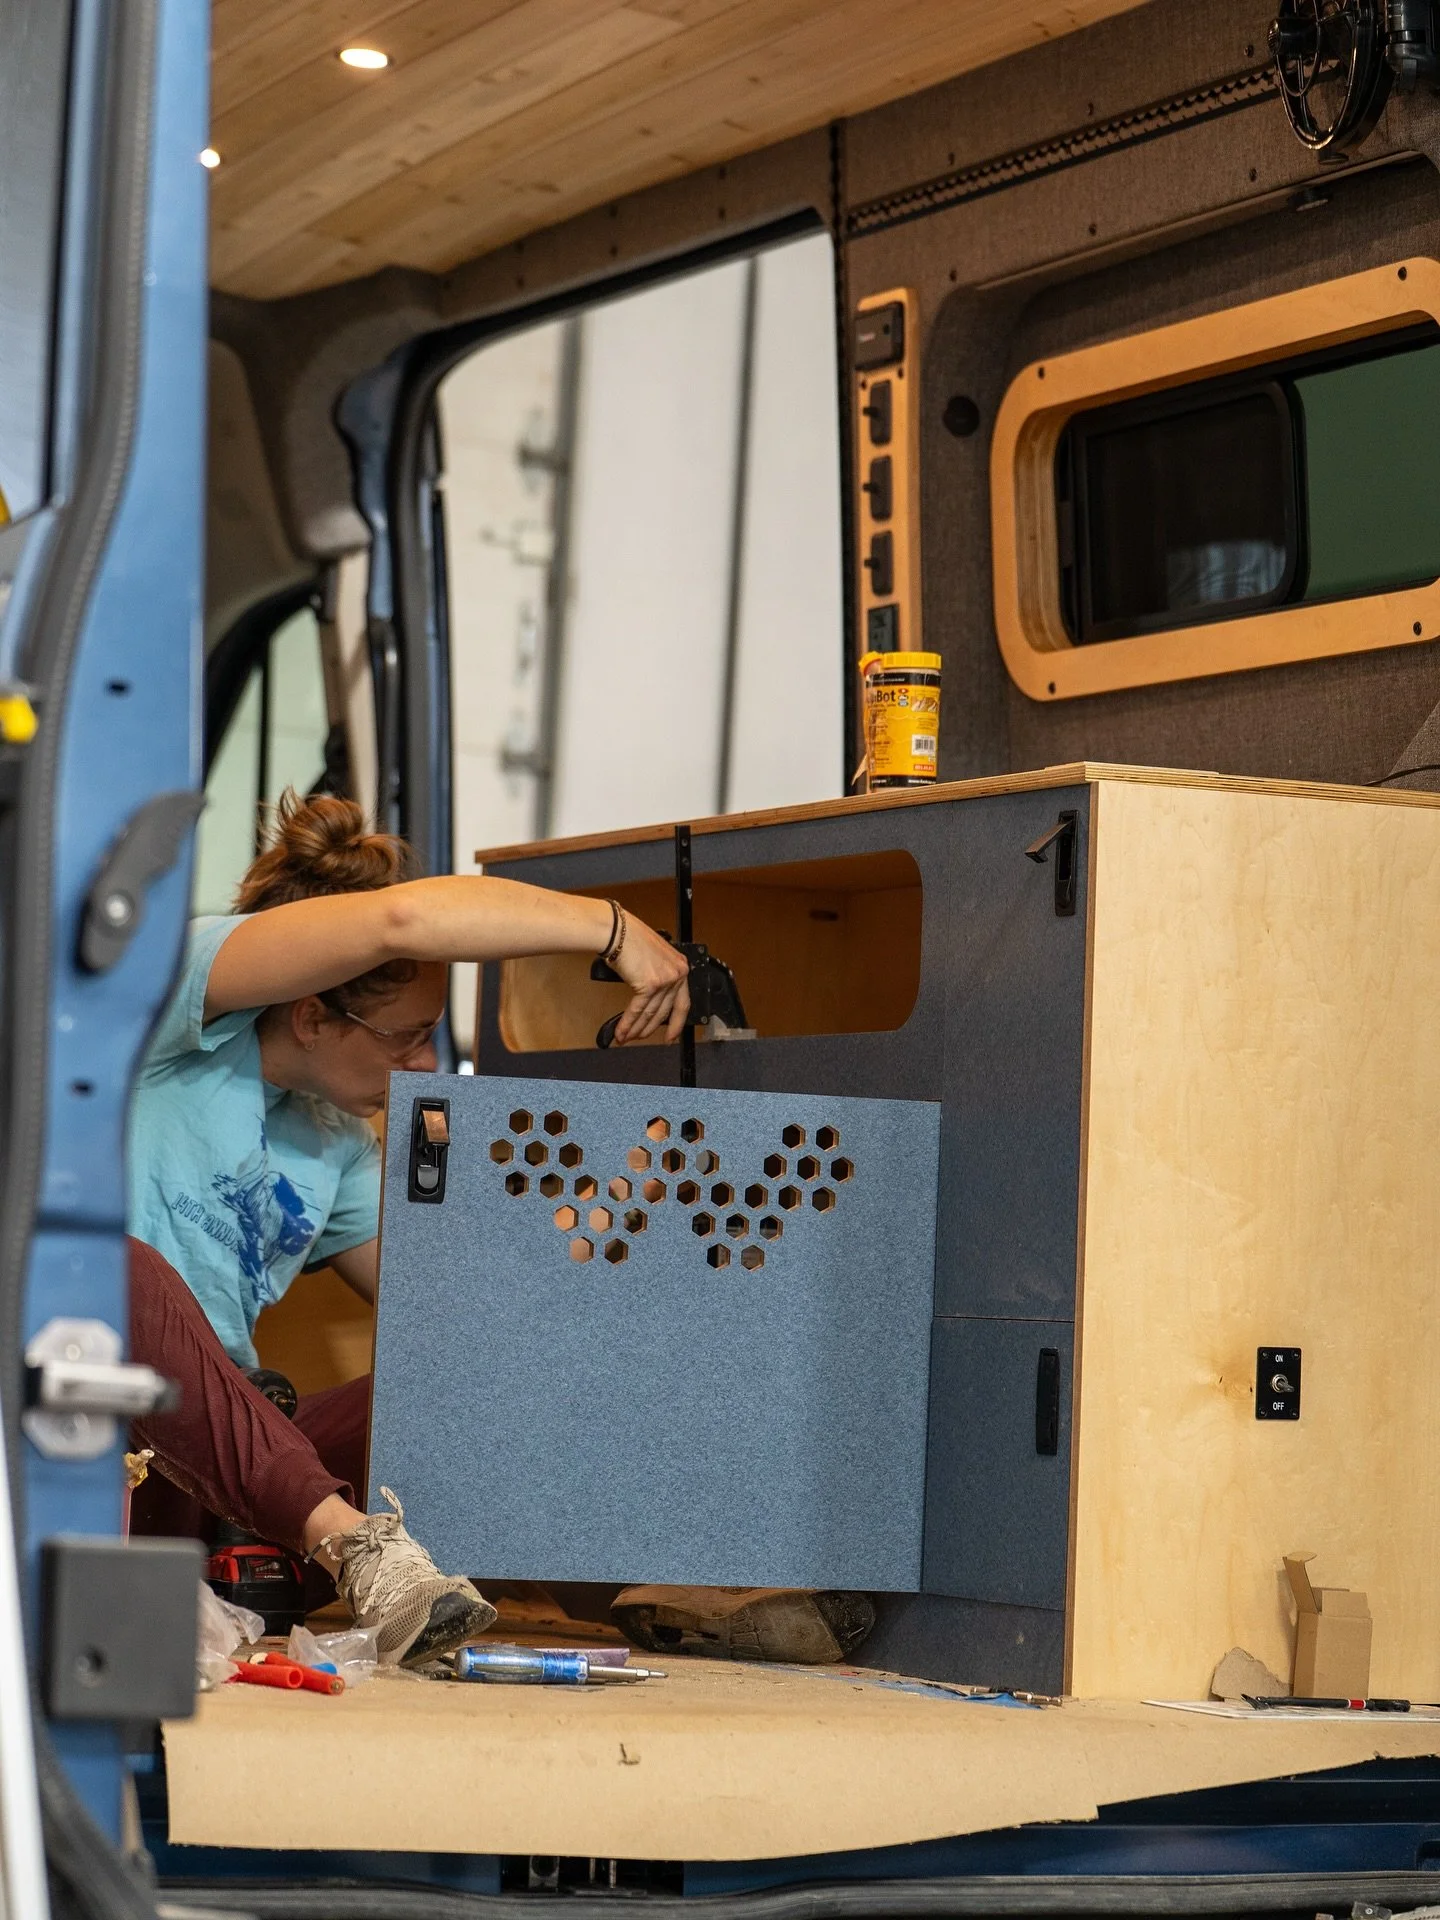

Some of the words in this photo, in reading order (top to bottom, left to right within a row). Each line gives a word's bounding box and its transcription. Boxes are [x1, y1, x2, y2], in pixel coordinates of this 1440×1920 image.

[171, 1192, 205, 1224] 14TH
[1275, 1354, 1284, 1363] ON
[1272, 1402, 1285, 1411] OFF
